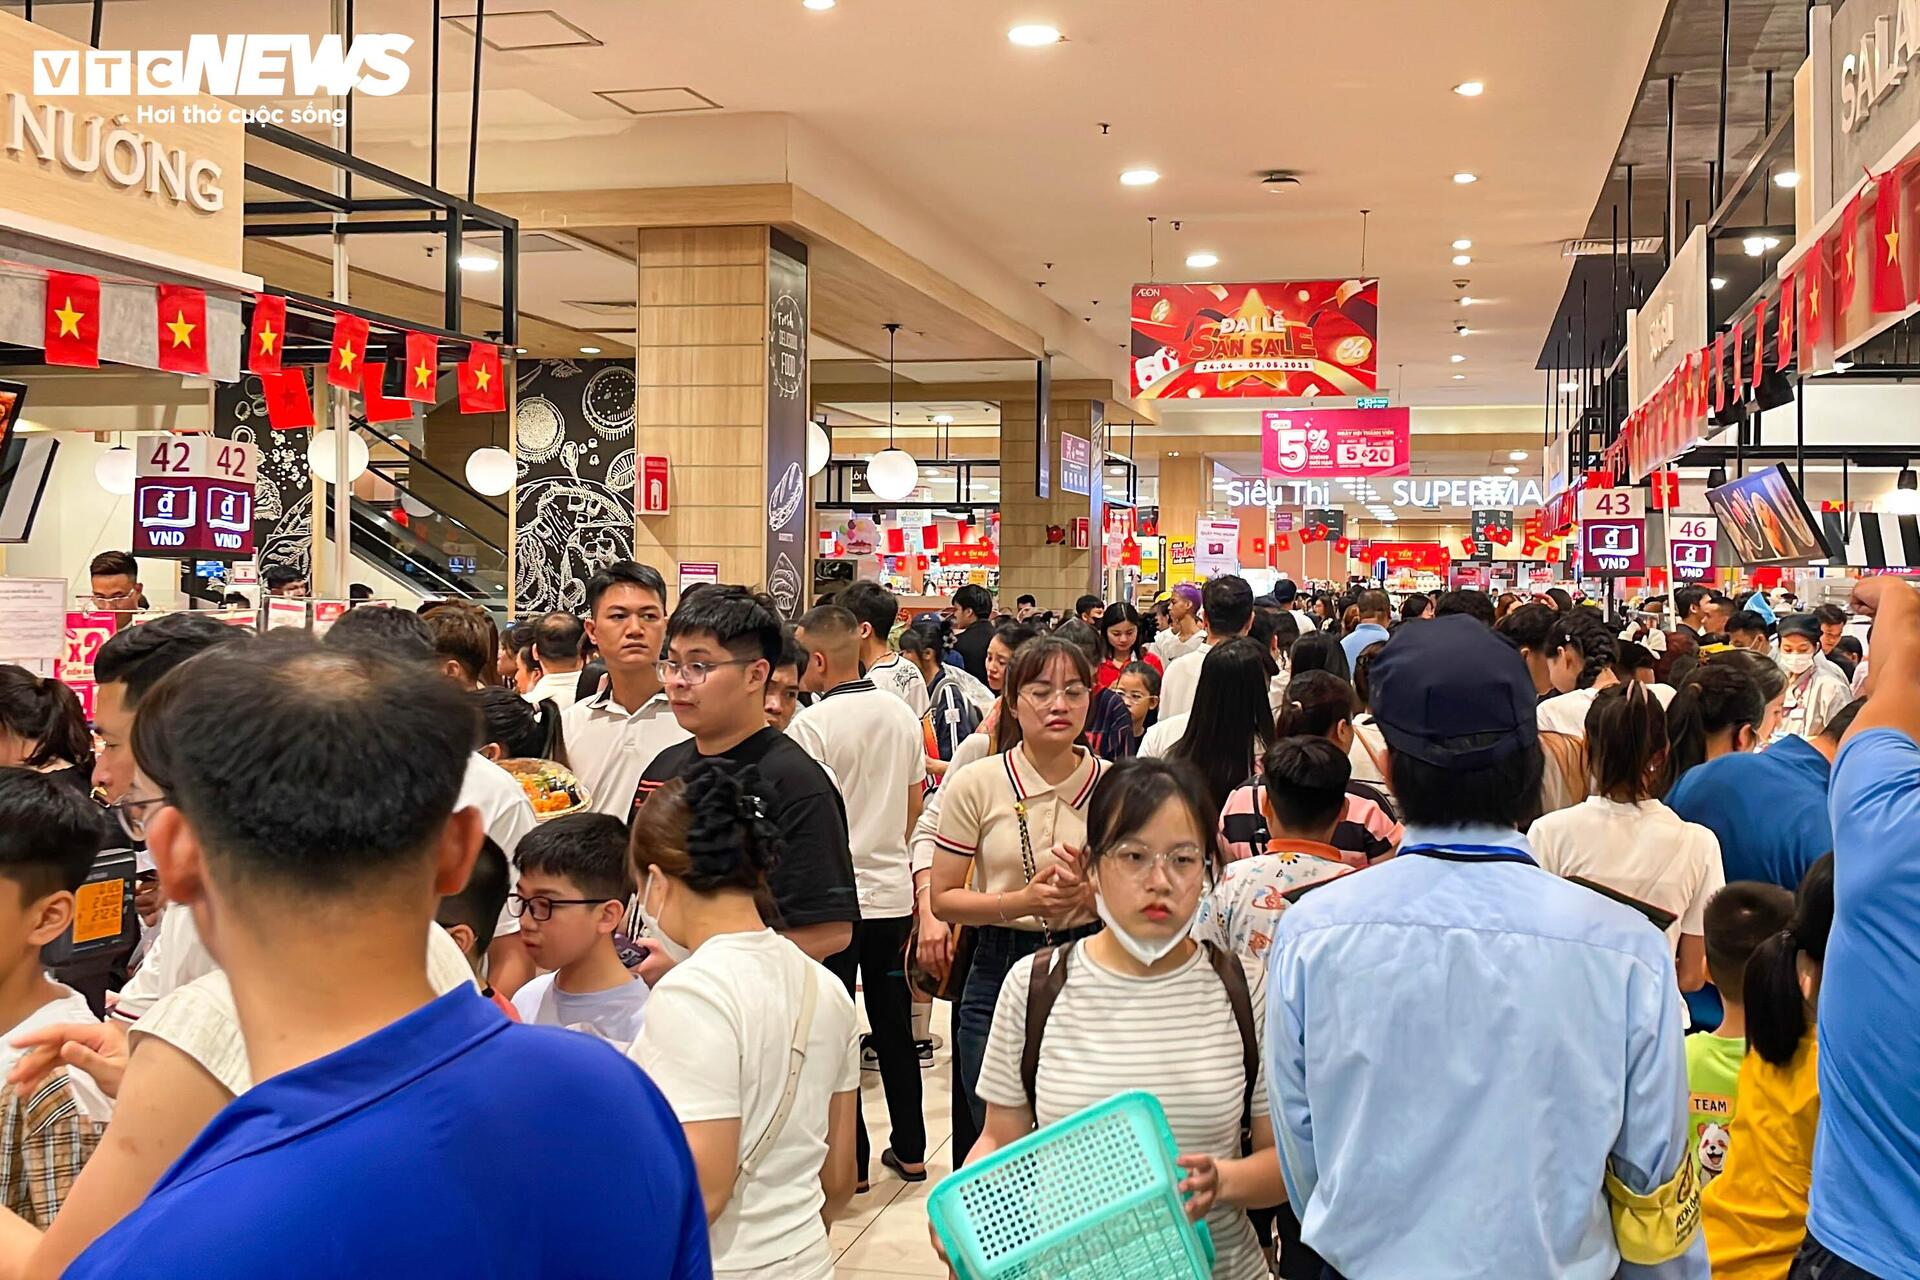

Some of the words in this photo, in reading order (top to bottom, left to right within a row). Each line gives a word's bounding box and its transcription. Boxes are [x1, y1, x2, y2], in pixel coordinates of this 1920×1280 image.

[1841, 0, 1920, 134] SALA
[1220, 317, 1256, 337] ĐẠI
[1263, 310, 1287, 334] LỄ
[1189, 327, 1244, 359] SĂN
[1250, 326, 1318, 359] SALE
[150, 442, 191, 472] 42
[216, 445, 247, 477] 42
[1346, 447, 1357, 461] 5
[1368, 448, 1391, 462] 20
[1287, 479, 1330, 511] Thị
[1595, 493, 1631, 516] 43
[149, 531, 185, 546] VND
[1680, 521, 1707, 538] 46
[214, 532, 243, 549] VND
[1598, 558, 1630, 570] VND
[1680, 567, 1704, 578] VND
[1694, 1098, 1727, 1113] TEAM
